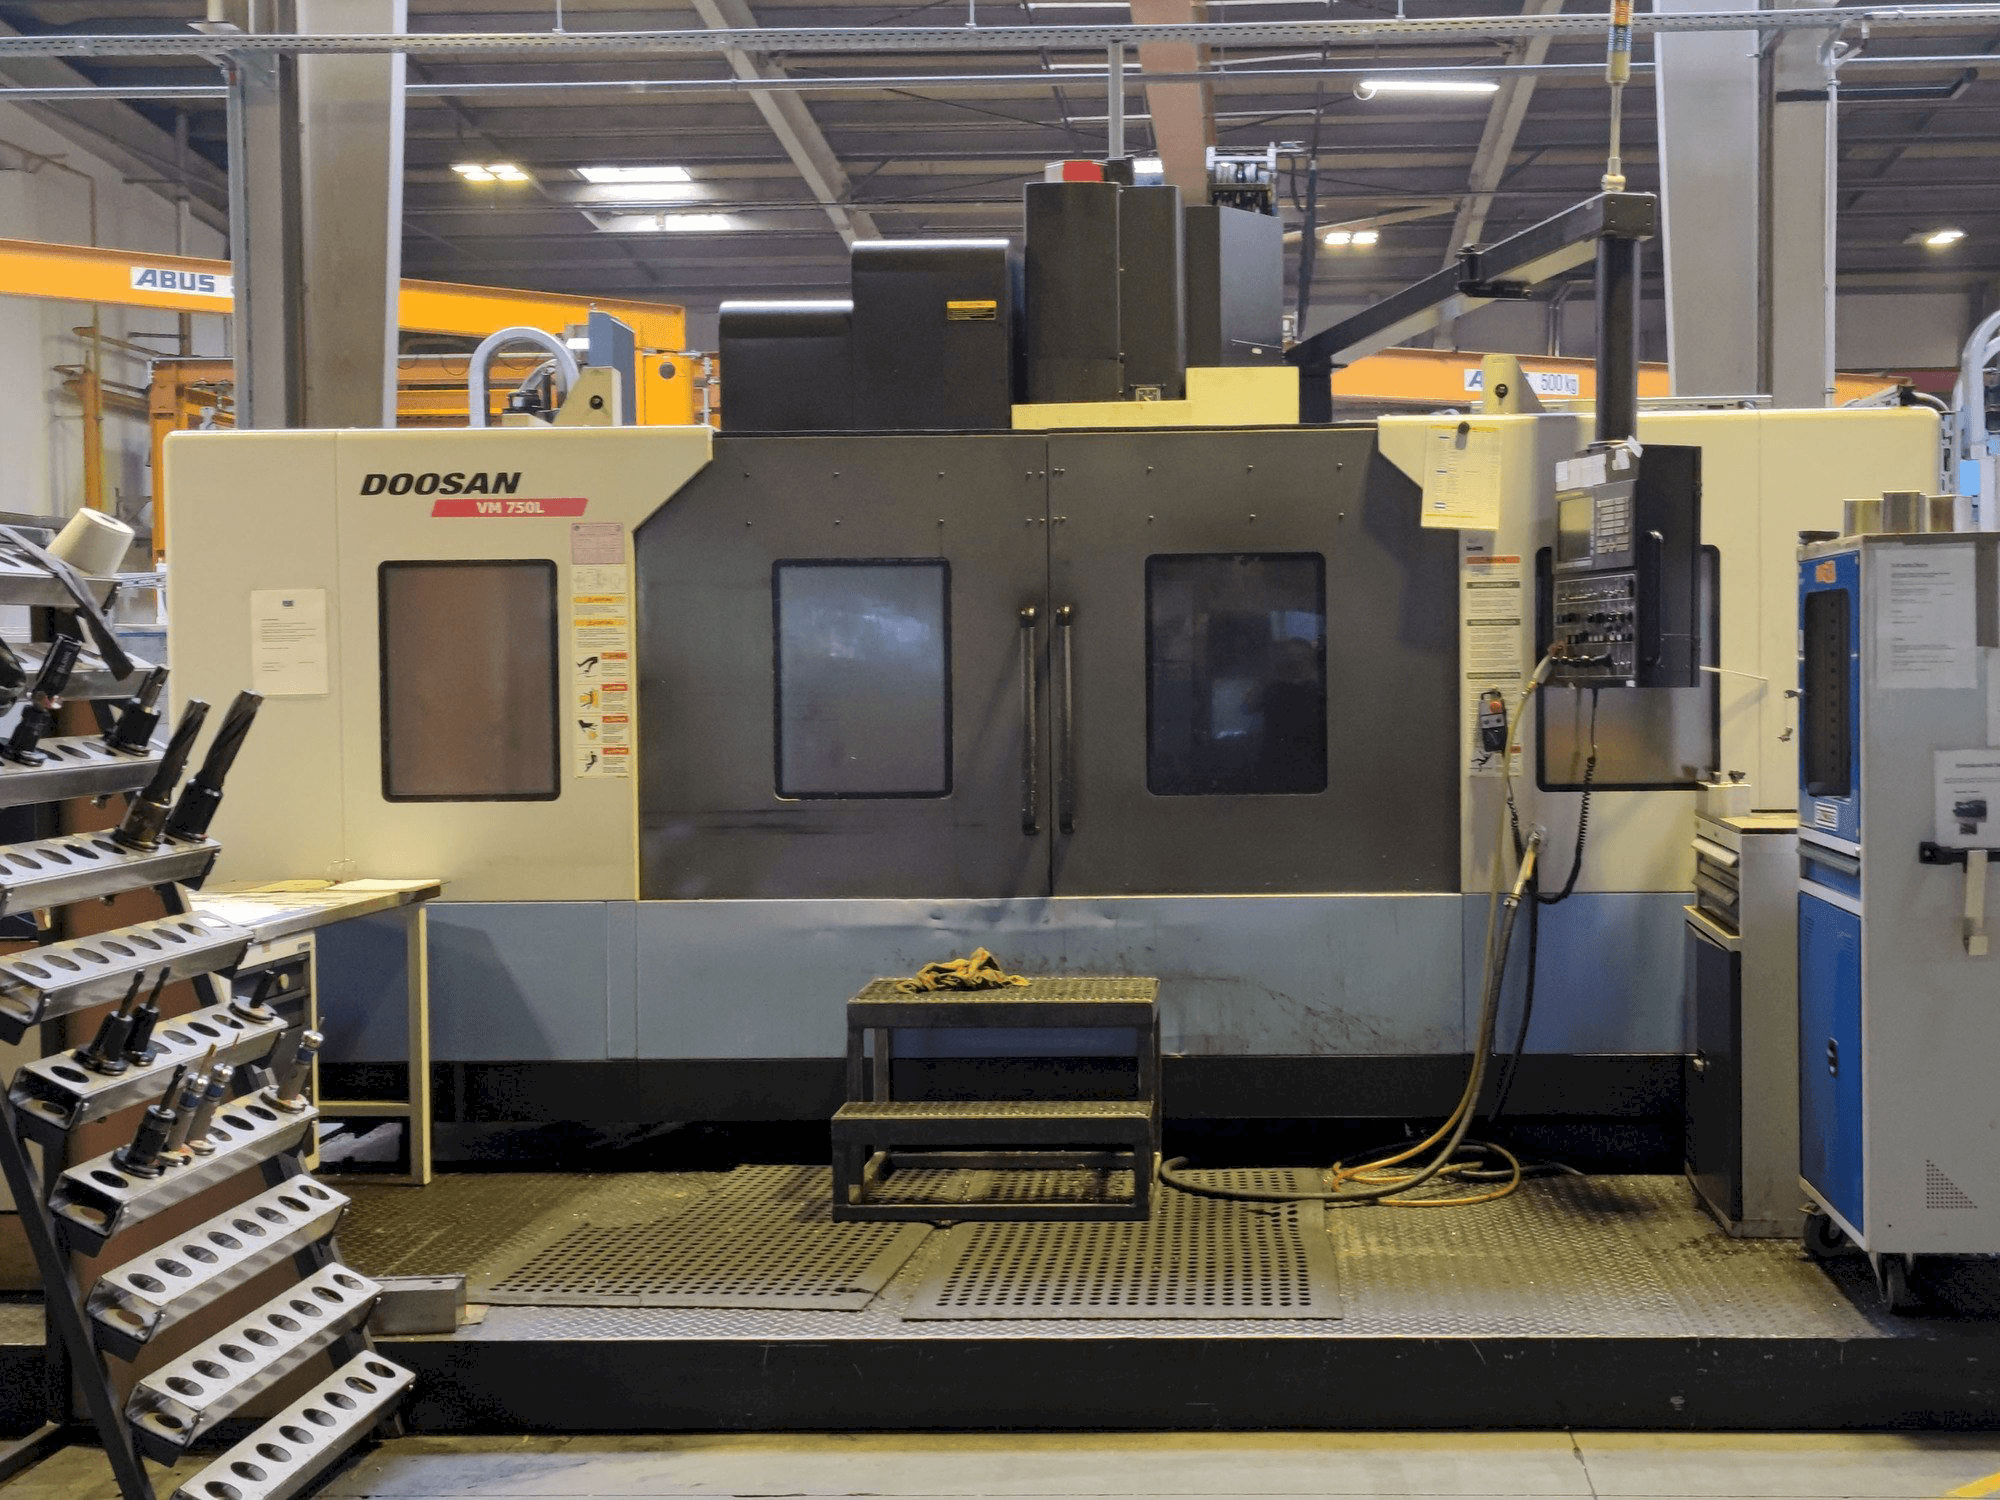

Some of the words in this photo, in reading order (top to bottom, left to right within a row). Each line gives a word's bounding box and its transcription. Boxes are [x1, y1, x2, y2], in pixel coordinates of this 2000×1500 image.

[134, 269, 215, 293] ABUS
[359, 472, 522, 496] DOOSAN
[475, 501, 502, 514] VM
[506, 501, 545, 514] 750L
